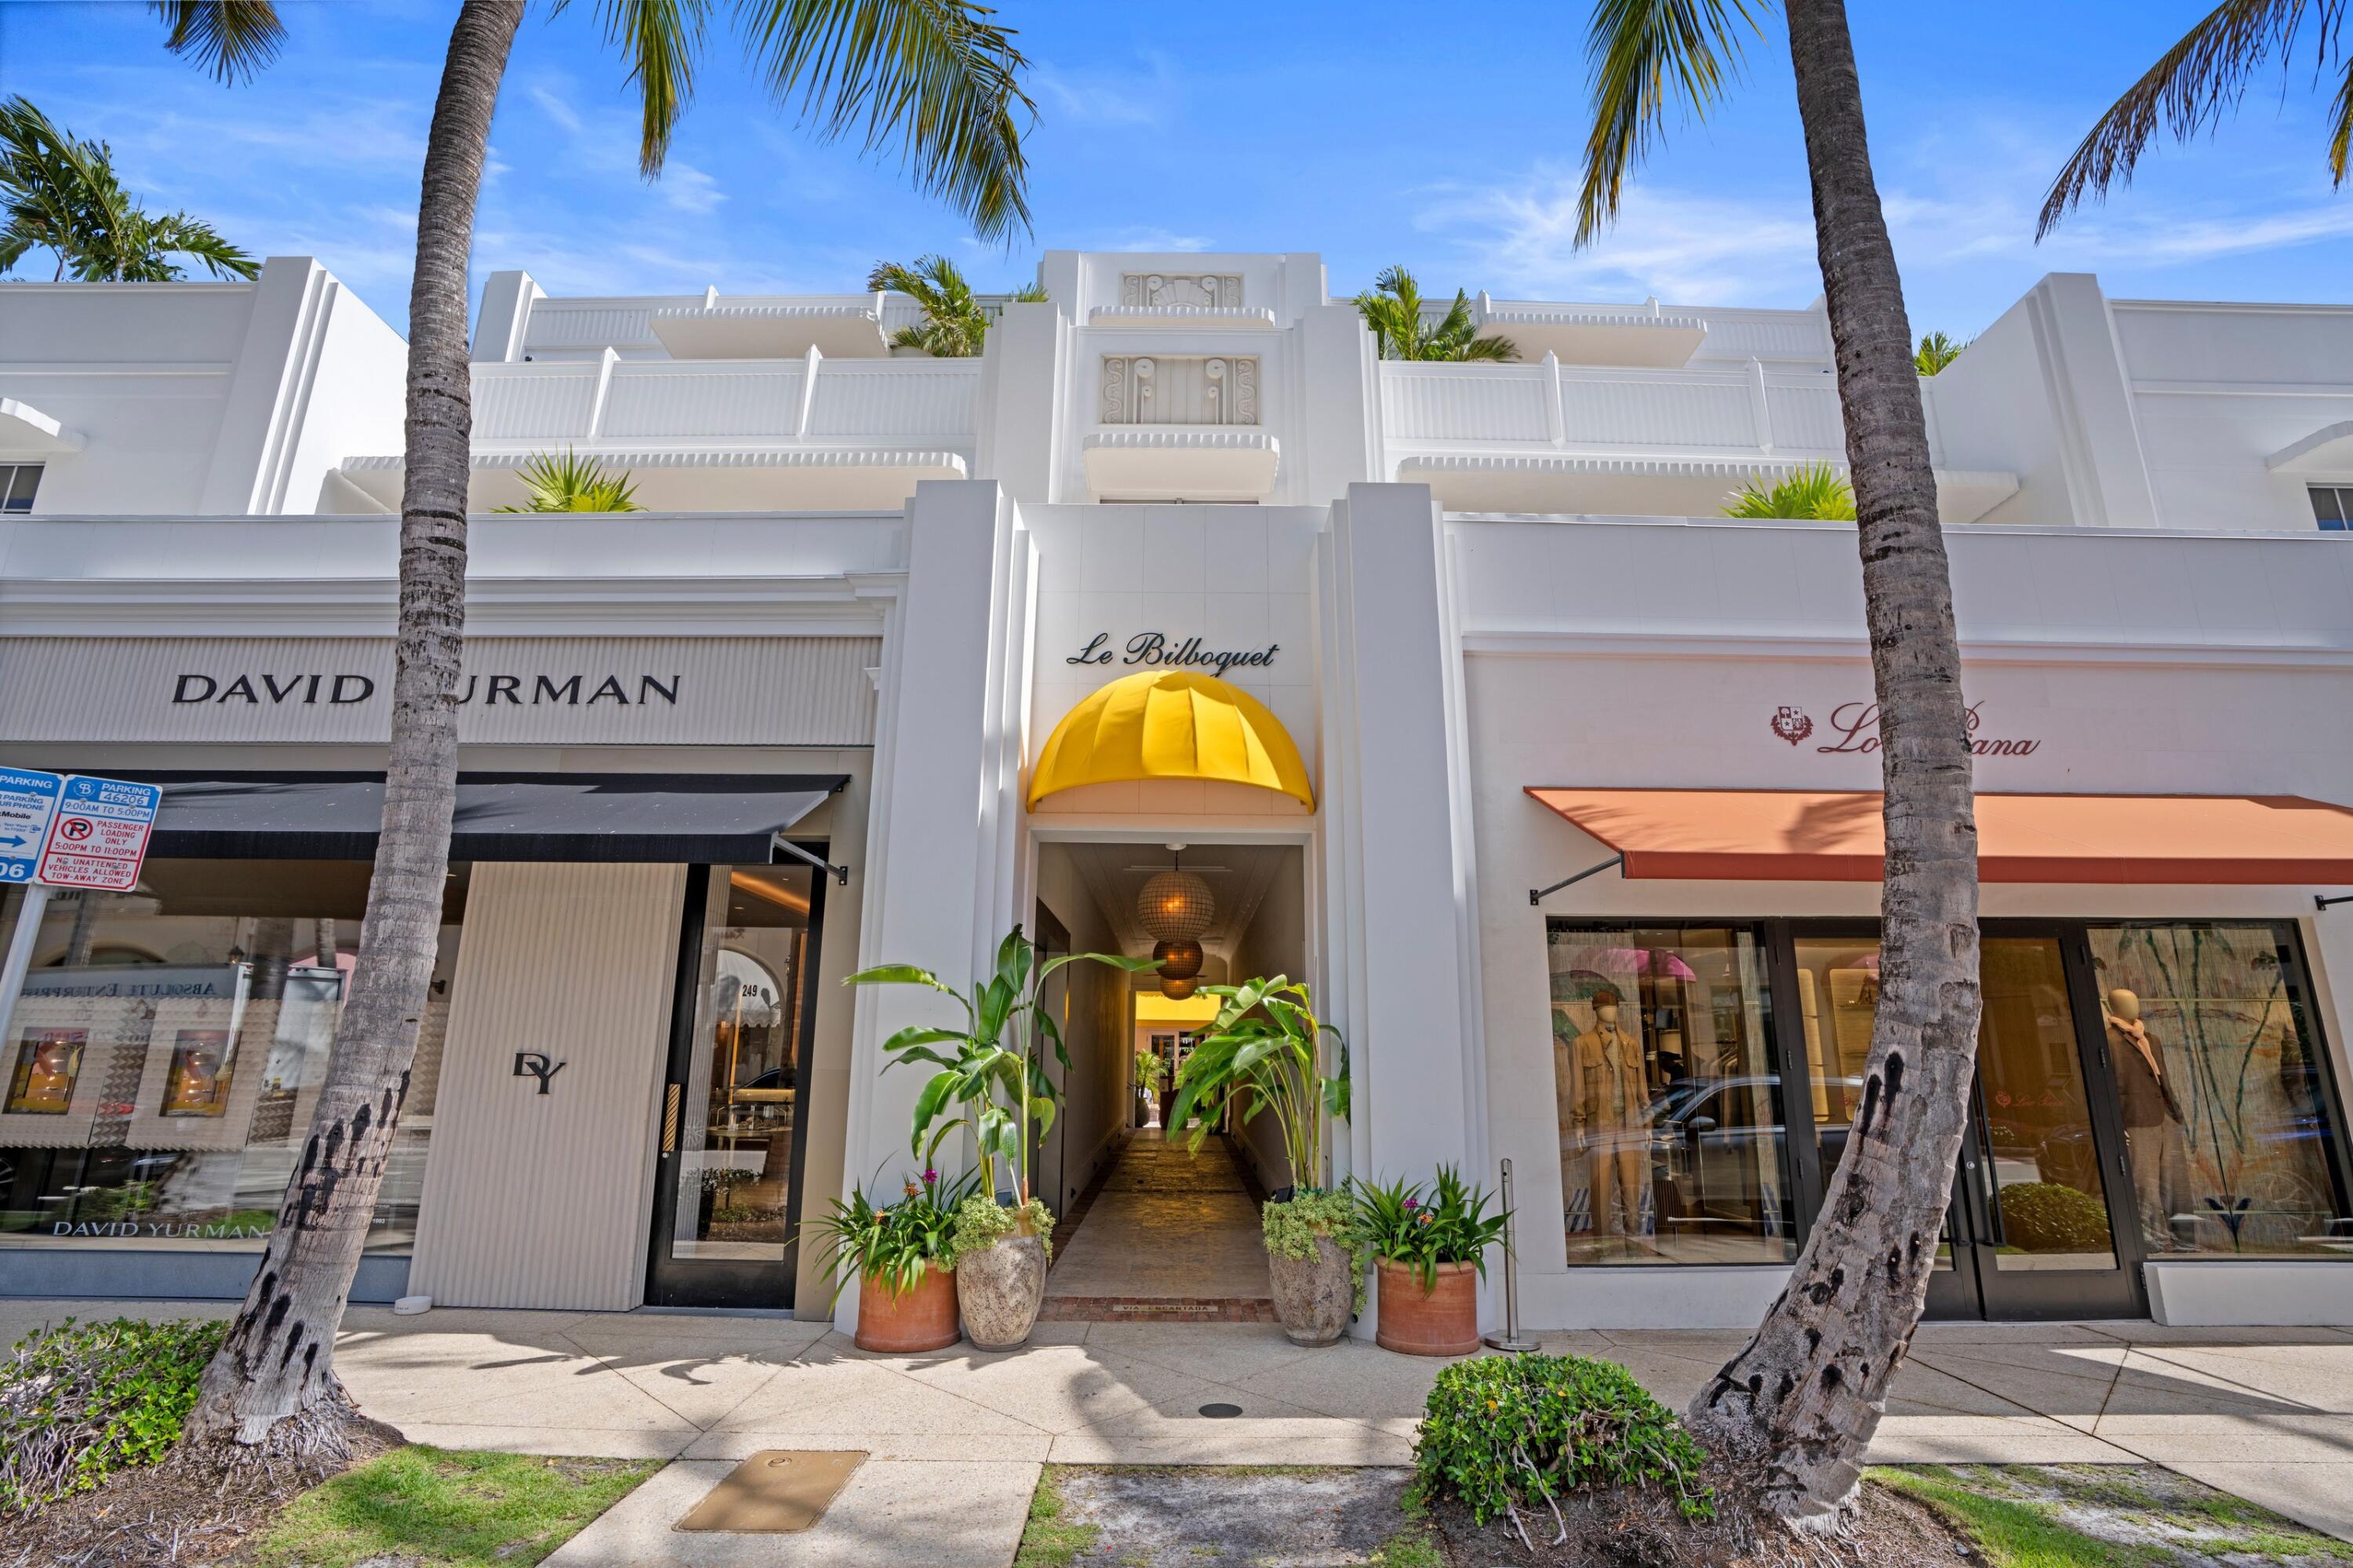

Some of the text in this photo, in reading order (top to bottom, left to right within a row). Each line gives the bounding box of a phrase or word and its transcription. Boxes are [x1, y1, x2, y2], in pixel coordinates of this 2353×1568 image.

[1066, 632, 1280, 678] Le Bilboquet
[172, 674, 681, 704] DAVID RMAN
[1817, 702, 1882, 753] Lo
[0, 775, 53, 788] PARKING
[101, 783, 151, 795] PARKING
[2, 795, 44, 804] PARKING
[104, 792, 144, 805] 46206
[13, 802, 45, 811] PHONE
[64, 802, 99, 812] 9:00AM
[117, 808, 150, 818] 5:00PM
[96, 820, 144, 831] PASSENGER
[100, 829, 136, 839] LOADING
[105, 837, 127, 846] ONLY
[55, 842, 88, 851] 5:00PM
[104, 847, 137, 857] 11:00PM
[49, 864, 131, 878] VEHICLES ALLOWED
[52, 872, 97, 882] TOW-AWAY
[742, 984, 758, 997] 249
[53, 1221, 266, 1239] DAVID YURMAN
